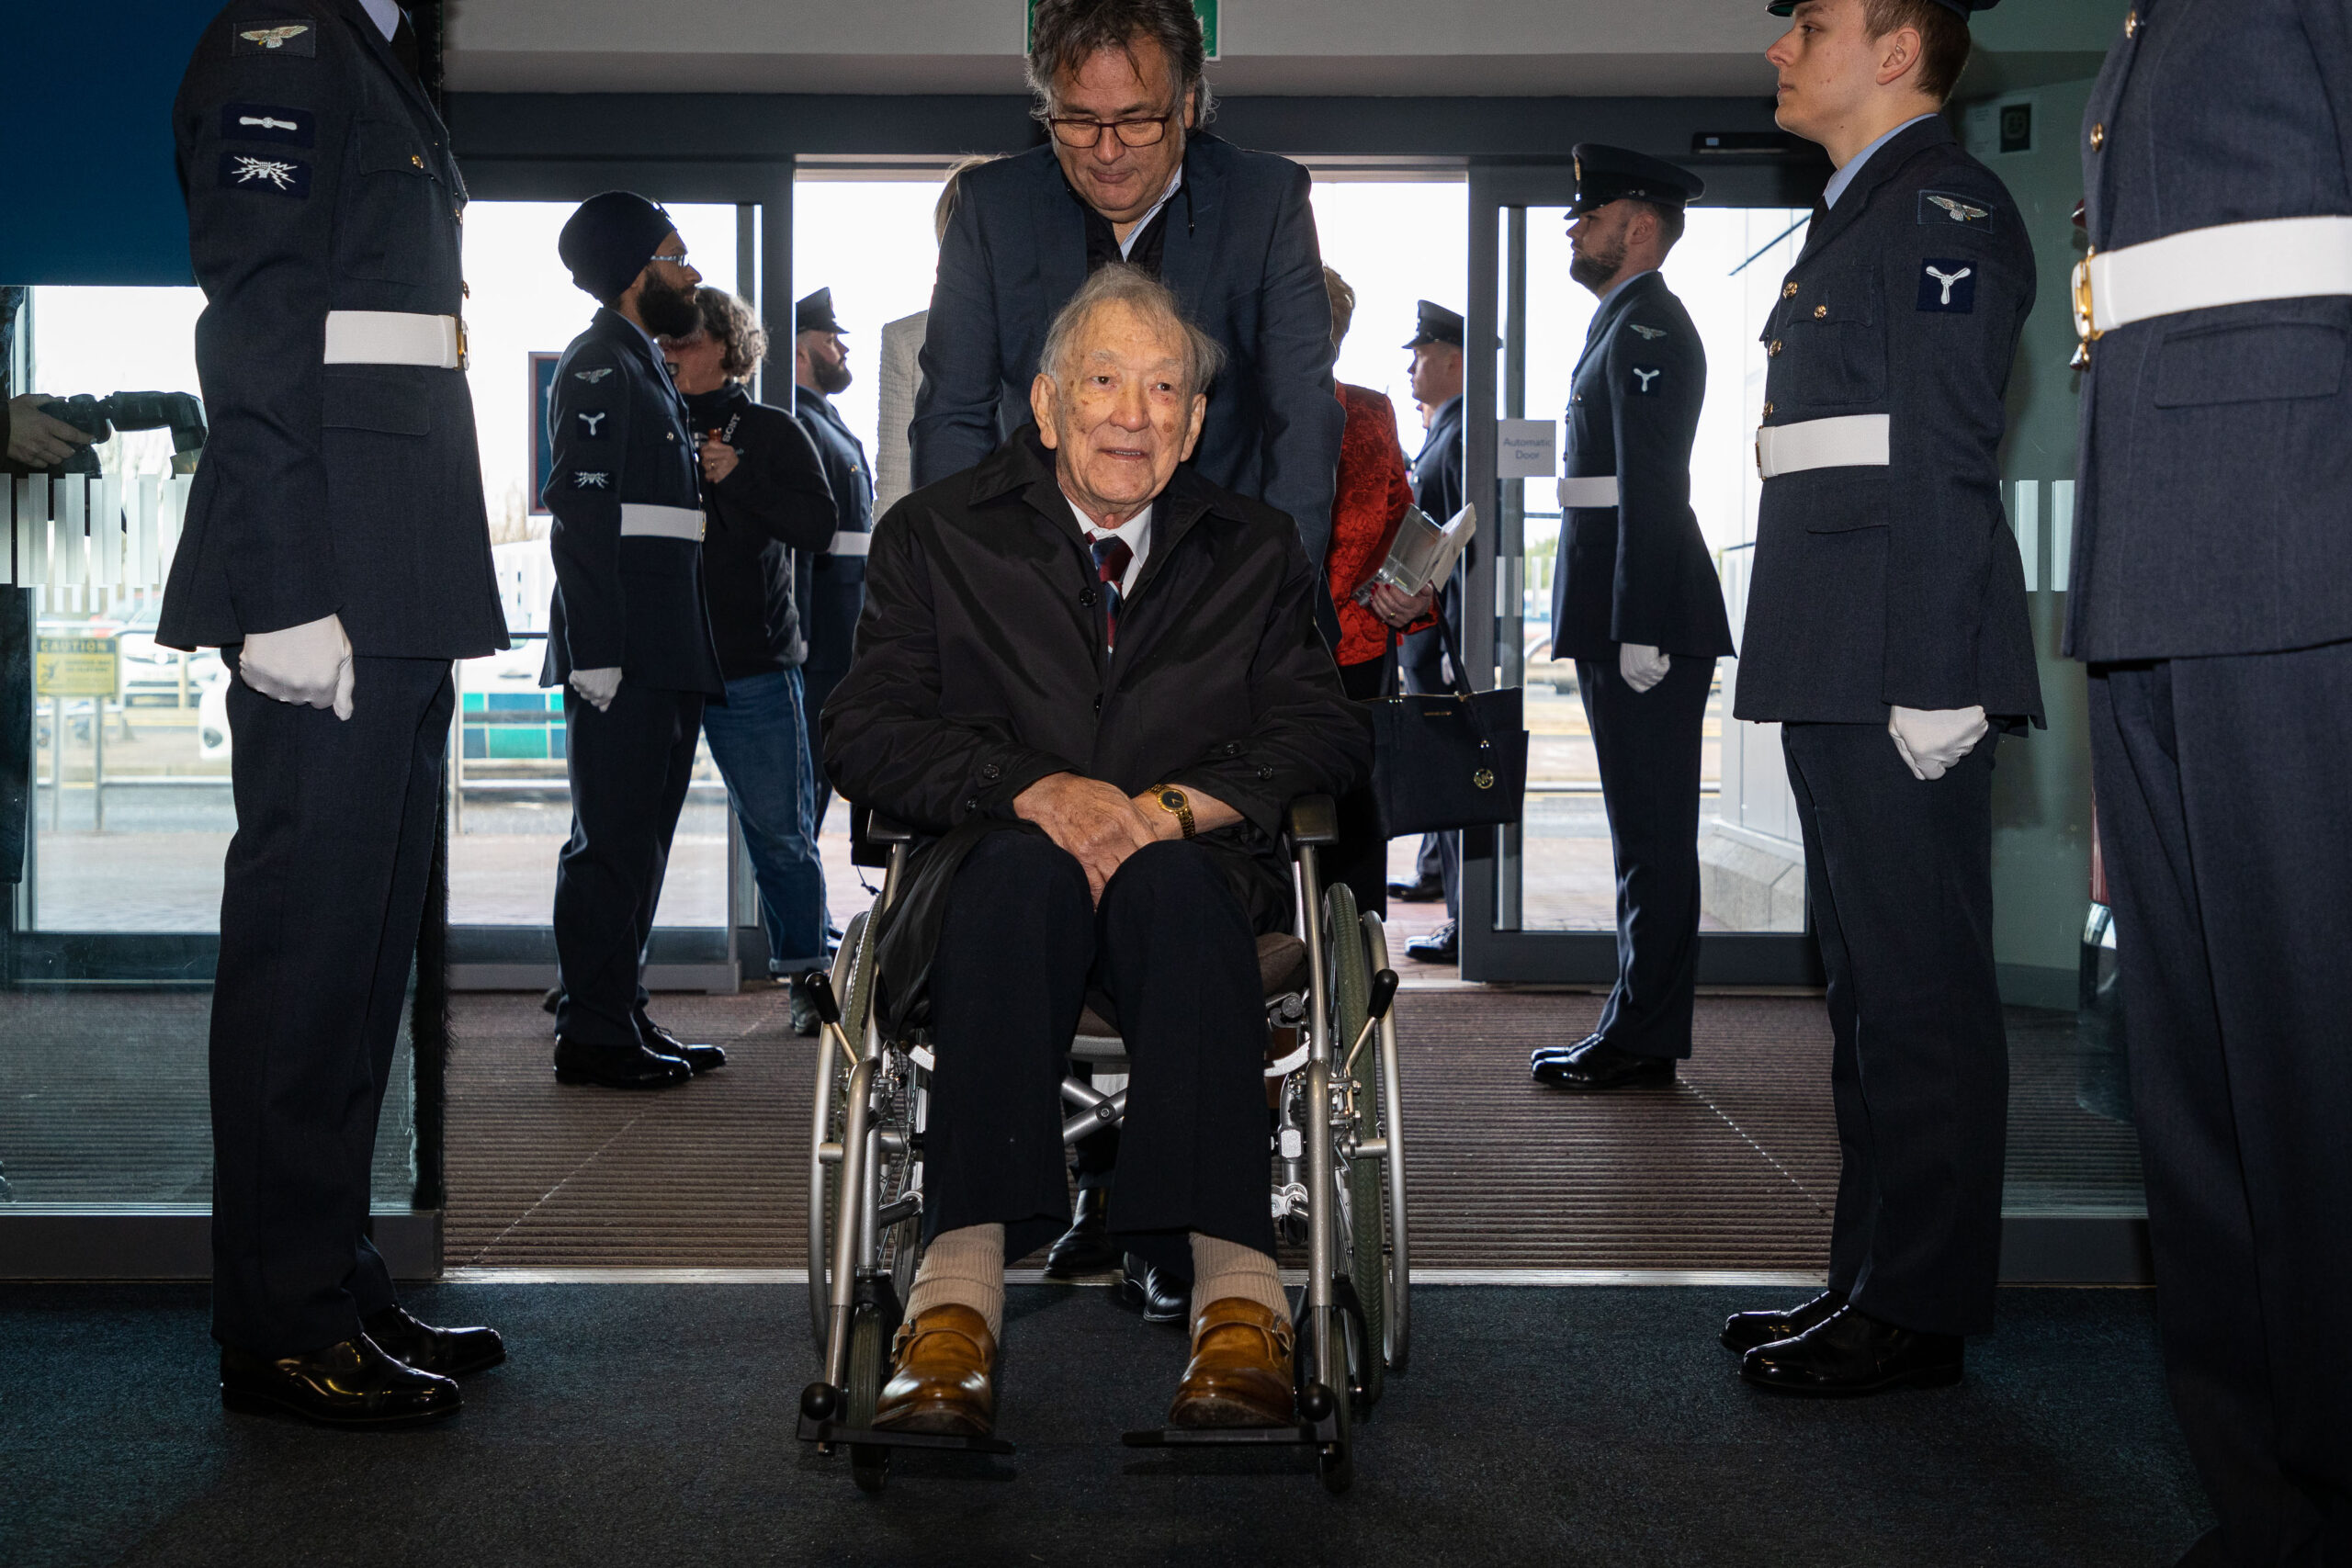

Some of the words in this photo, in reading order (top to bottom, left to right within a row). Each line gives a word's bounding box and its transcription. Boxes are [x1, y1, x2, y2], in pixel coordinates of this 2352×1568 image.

[722, 412, 741, 443] SONY
[1503, 437, 1553, 447] Automatic
[1515, 449, 1540, 459] Door
[40, 640, 107, 653] CAUTION
